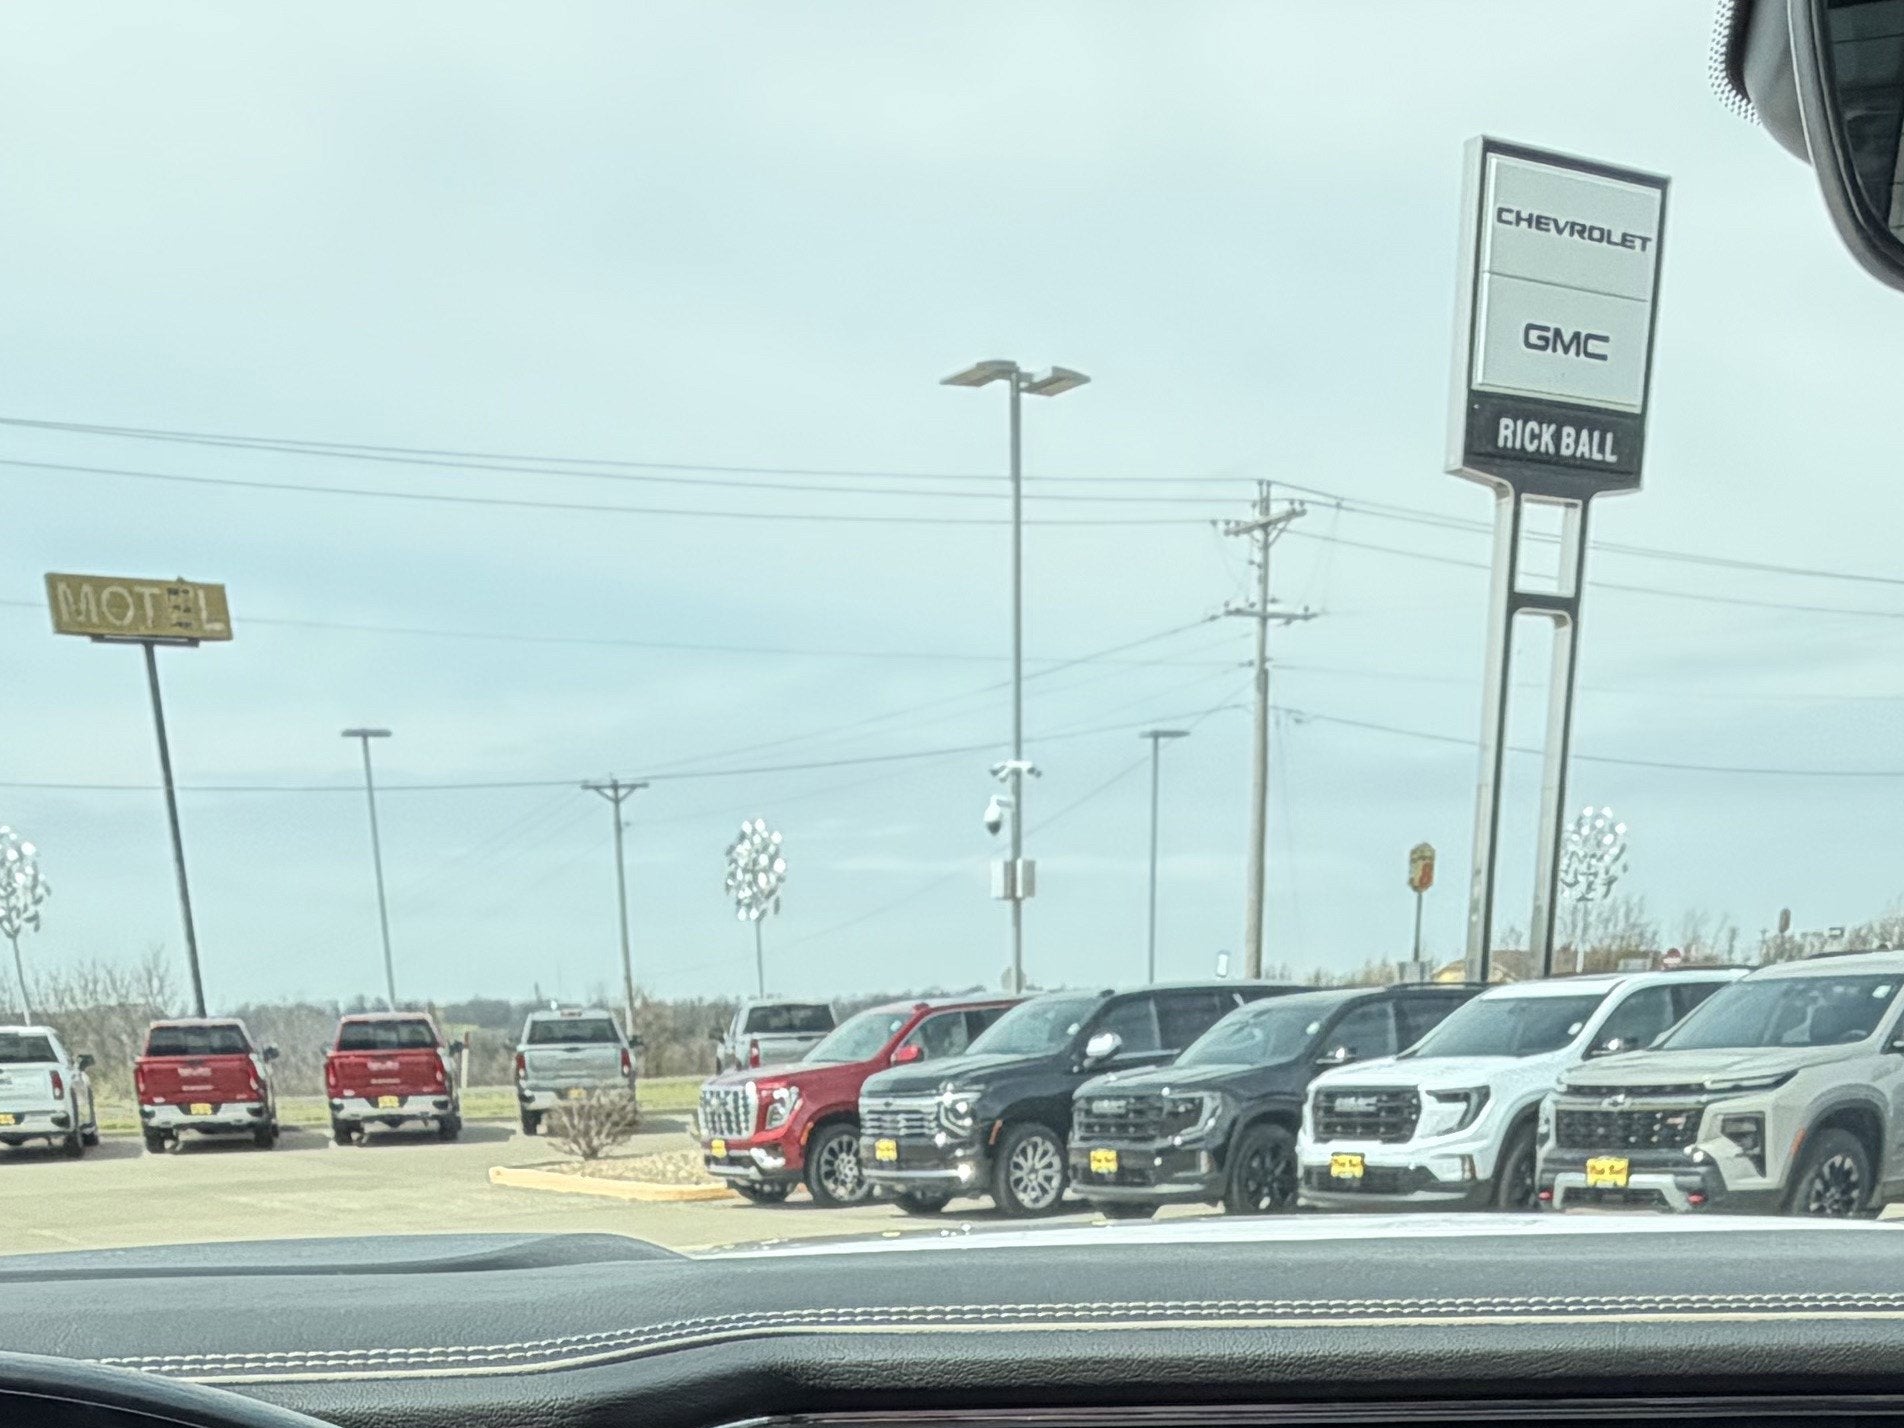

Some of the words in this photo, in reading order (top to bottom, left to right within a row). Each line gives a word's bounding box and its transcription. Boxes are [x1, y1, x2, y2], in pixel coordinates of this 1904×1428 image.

[1496, 206, 1653, 253] CHEVROLET
[1523, 322, 1611, 362] GMC
[1496, 417, 1558, 457] RICK
[1560, 425, 1619, 464] BALL
[56, 580, 226, 632] MOTEL
